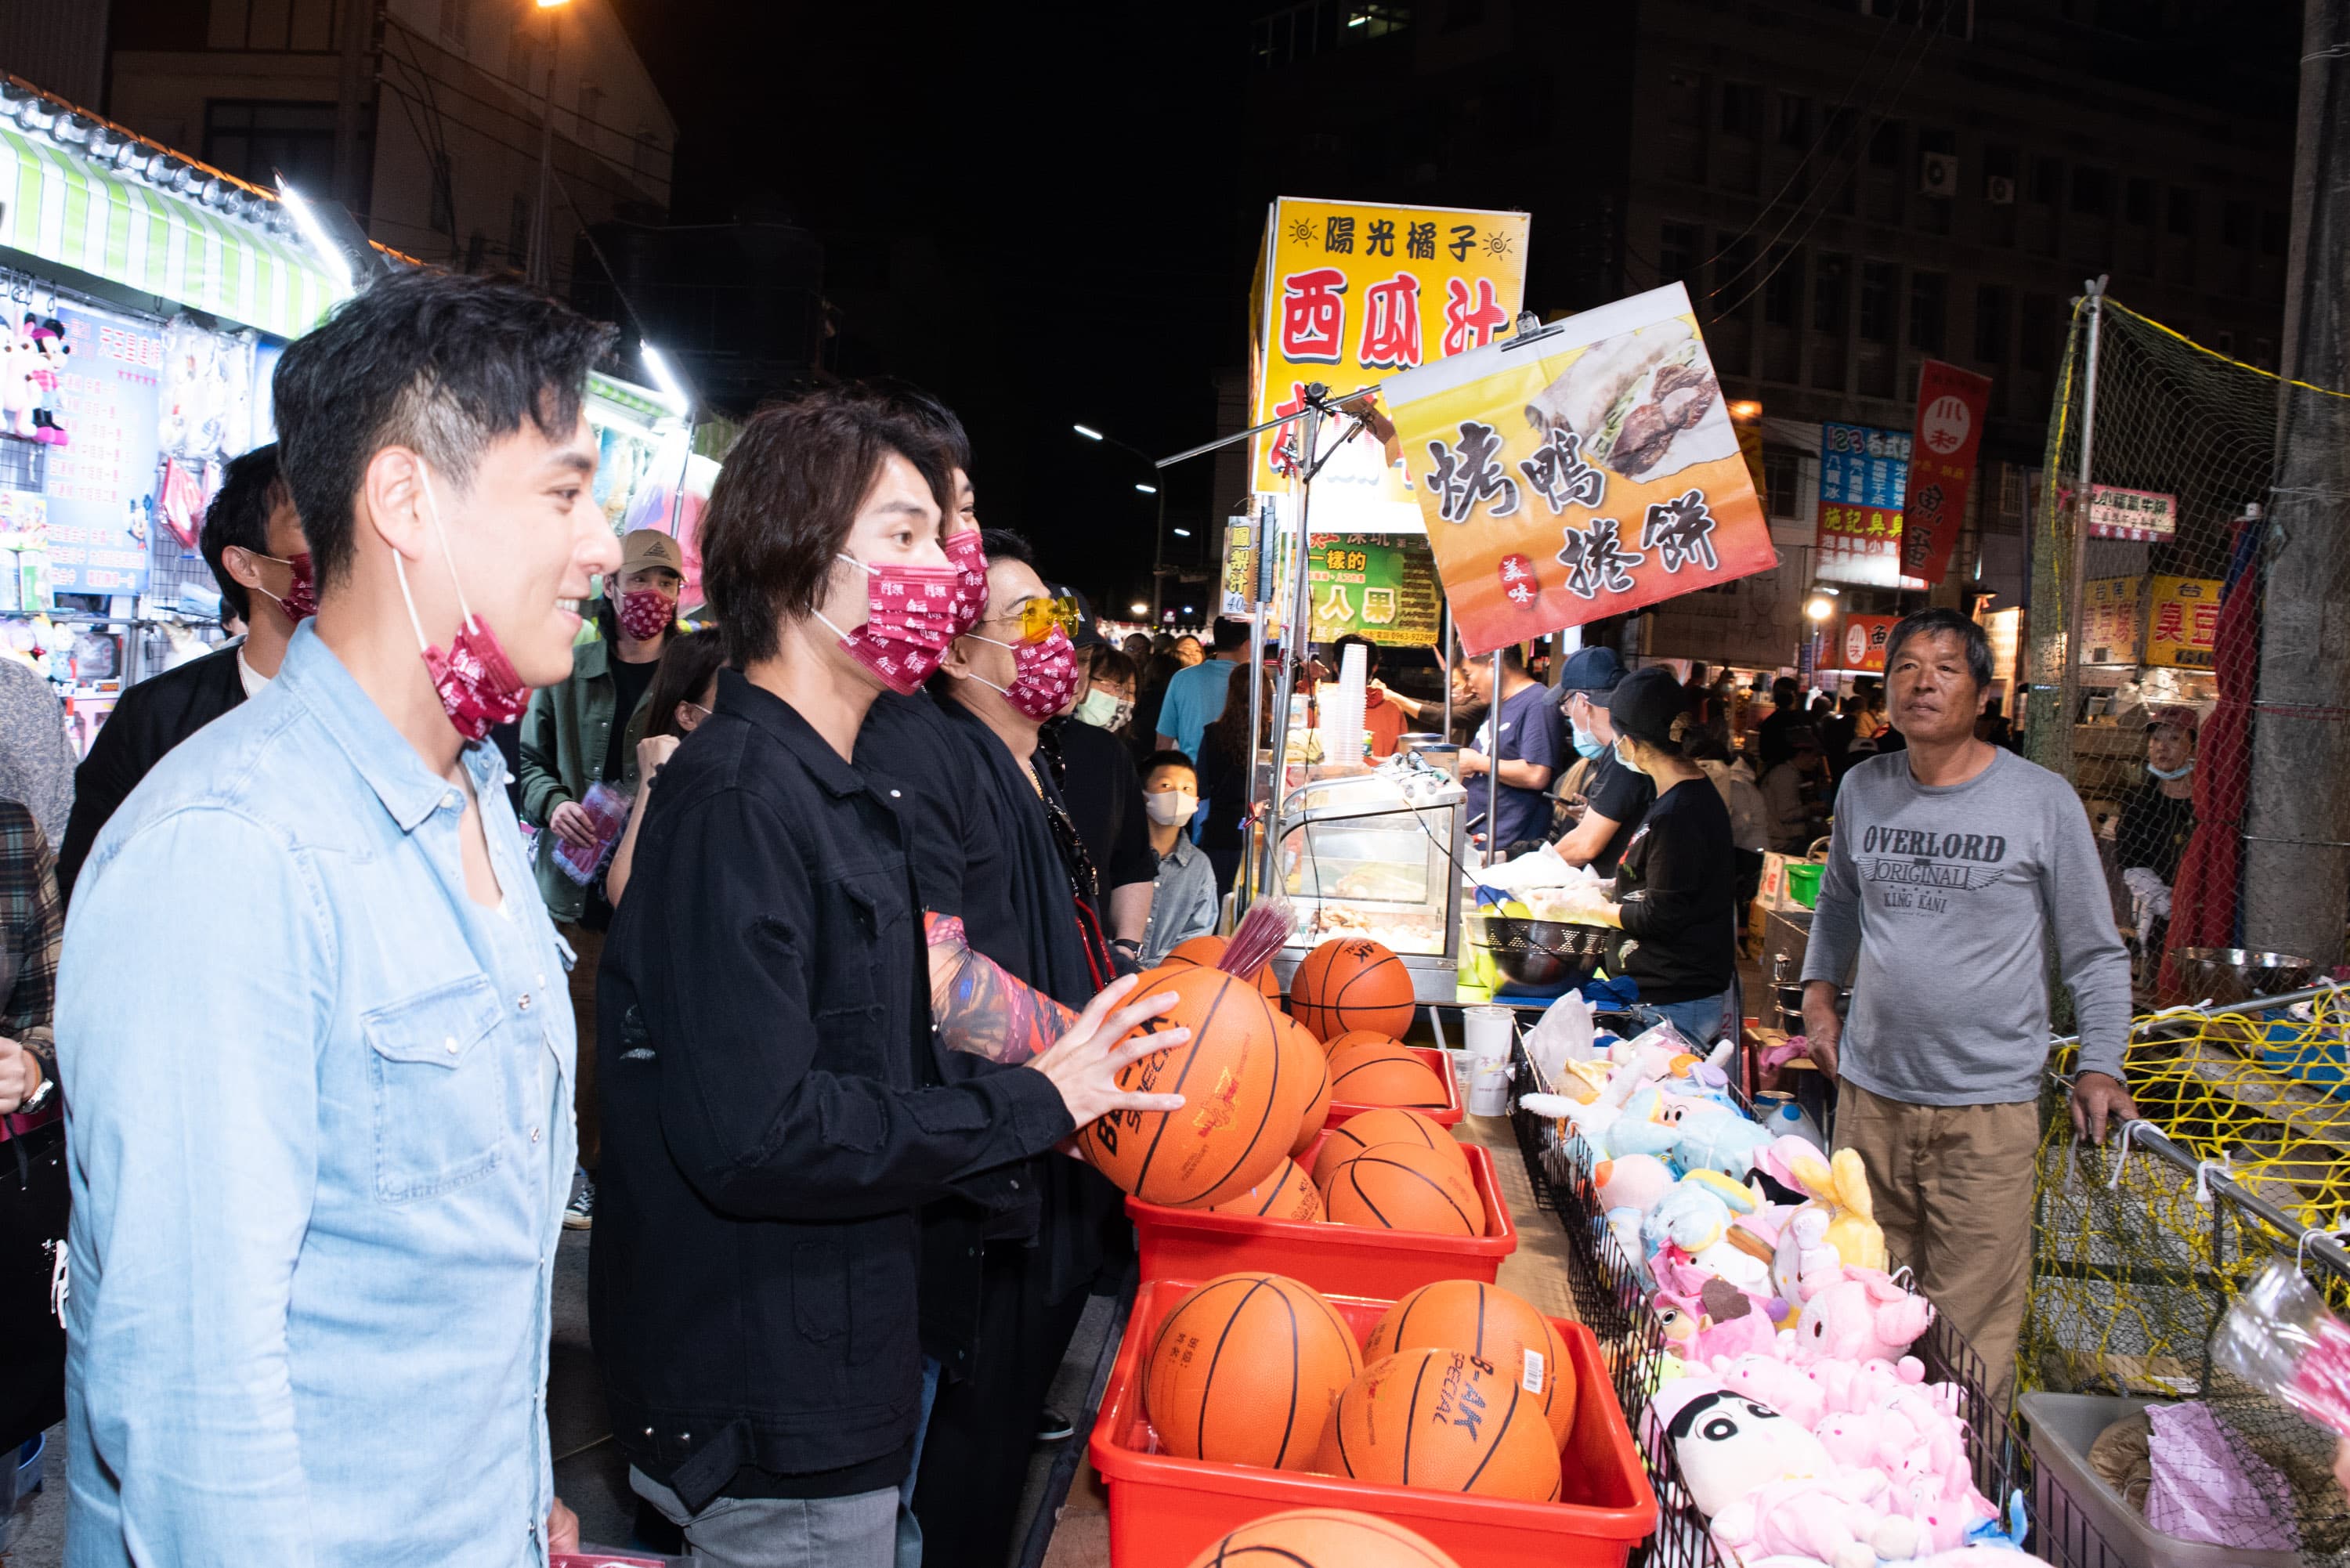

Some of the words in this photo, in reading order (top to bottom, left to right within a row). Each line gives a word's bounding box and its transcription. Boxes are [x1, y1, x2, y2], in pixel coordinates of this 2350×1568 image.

[1325, 216, 1477, 263] 陽光橘子
[1281, 267, 1509, 370] 西瓜汁
[1827, 426, 1865, 454] 123
[1425, 420, 1607, 523] 烤鴨
[1556, 488, 1719, 600] 捲餅
[1500, 558, 1535, 603] 美味
[1864, 825, 2007, 863] OVERLORD
[1878, 862, 1964, 887] ORIGINAL
[1884, 892, 1913, 909] KING
